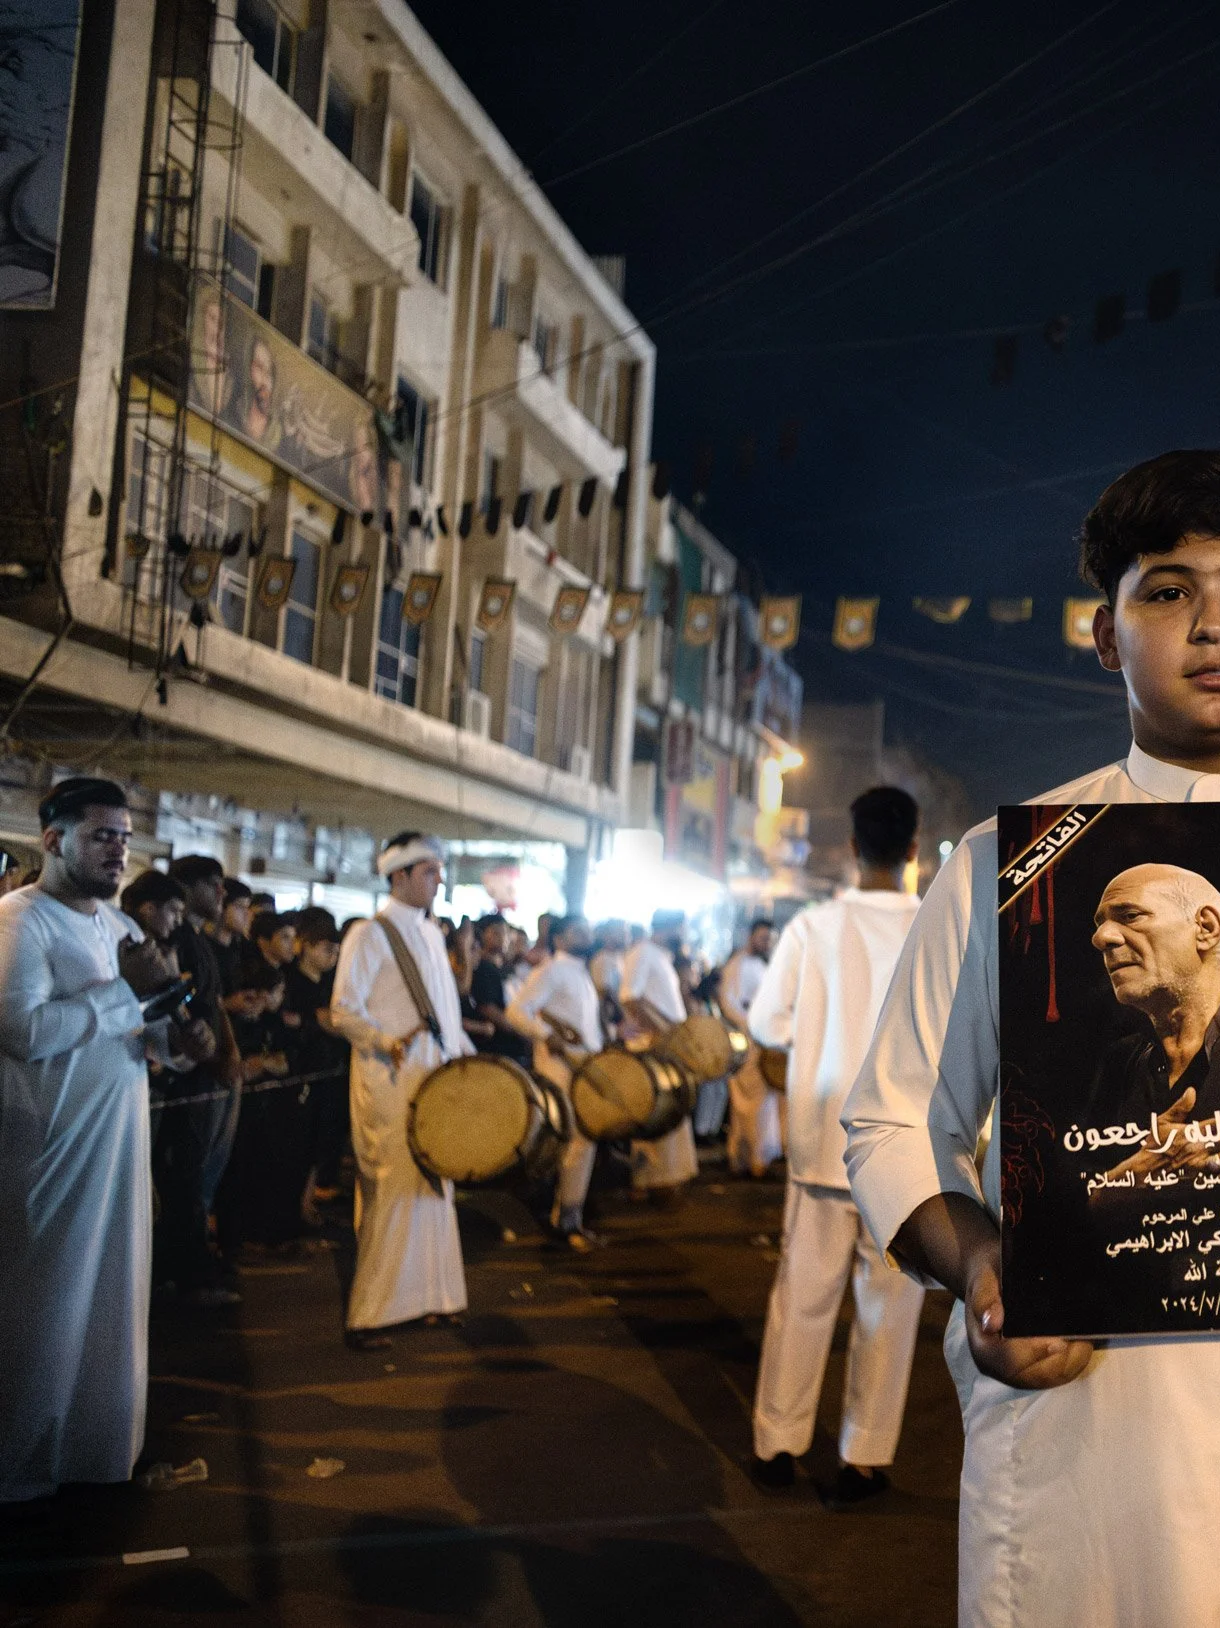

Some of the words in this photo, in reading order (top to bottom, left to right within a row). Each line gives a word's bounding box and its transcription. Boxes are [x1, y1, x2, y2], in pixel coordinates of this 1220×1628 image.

[1005, 811, 1087, 886] الفاتحة
[1063, 1111, 1177, 1154] راجعون
[1142, 1208, 1188, 1227] المرحوم
[1192, 1207, 1215, 1225] علي
[1106, 1230, 1190, 1258] الابراهيمي
[1183, 1259, 1207, 1282] الله
